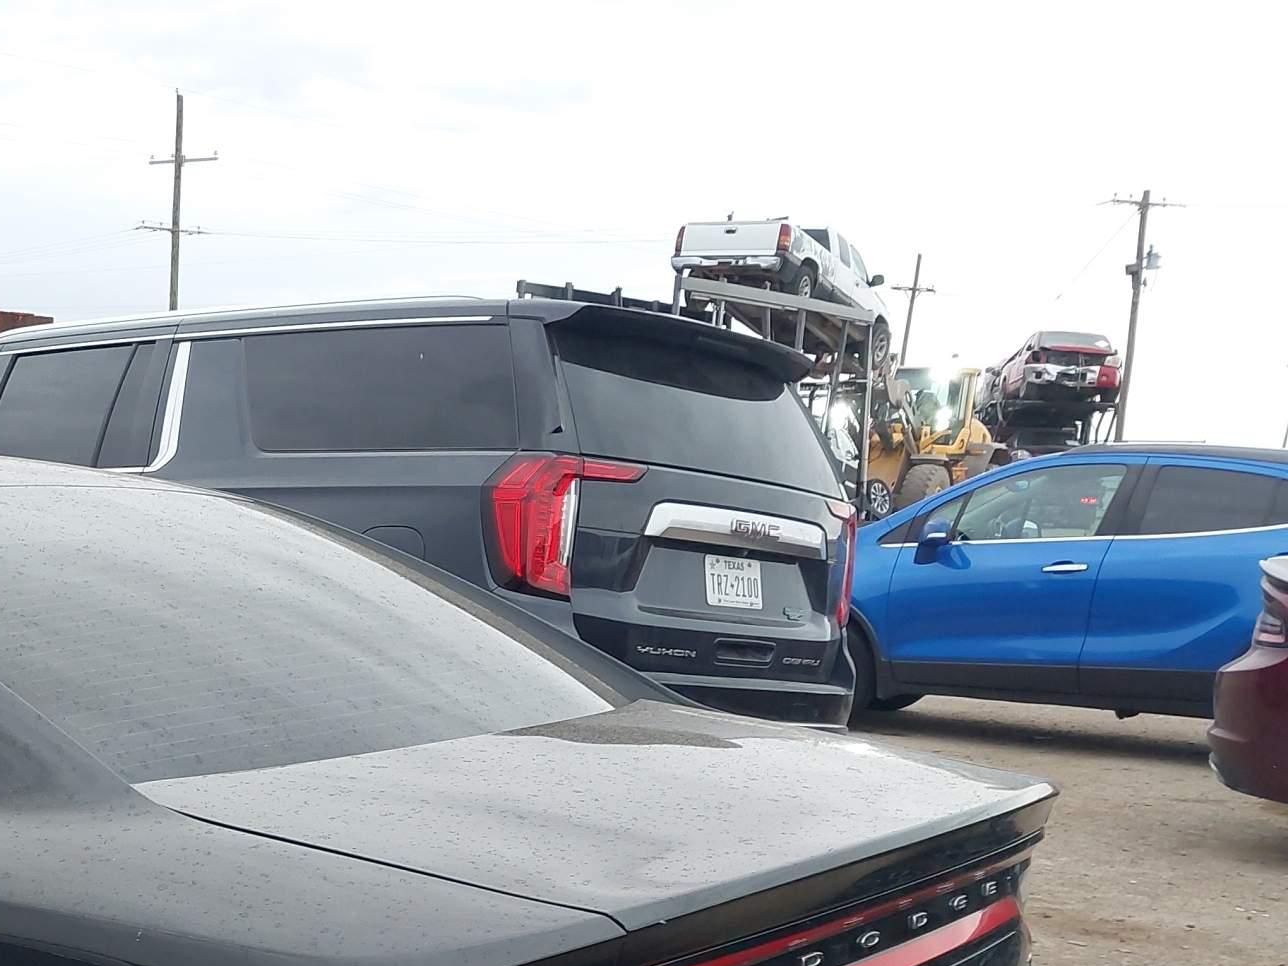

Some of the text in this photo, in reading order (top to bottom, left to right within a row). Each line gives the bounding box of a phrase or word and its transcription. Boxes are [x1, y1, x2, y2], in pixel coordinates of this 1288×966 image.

[730, 518, 781, 540] GMC
[724, 560, 745, 571] TEXAS
[636, 645, 697, 658] YUKON
